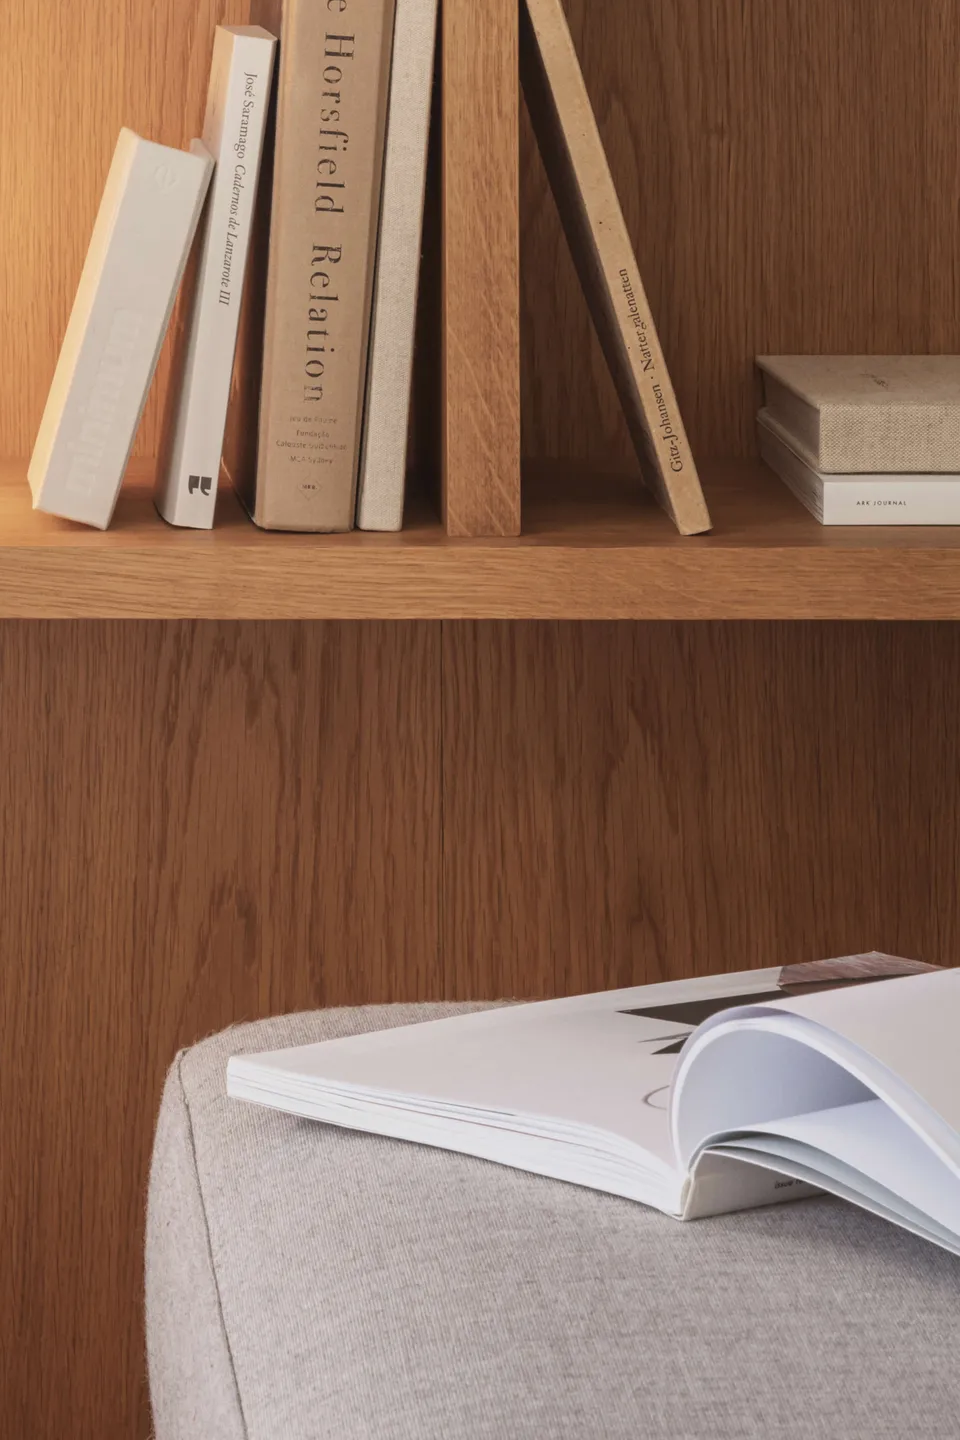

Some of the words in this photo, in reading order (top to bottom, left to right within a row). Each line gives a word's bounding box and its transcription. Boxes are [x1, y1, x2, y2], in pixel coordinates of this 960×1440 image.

[243, 71, 258, 97] José
[233, 100, 255, 159] Saramago
[314, 32, 355, 213] Horsfield
[228, 164, 246, 216] Cadernos
[227, 217, 240, 230] de
[220, 231, 238, 288] Lanzarote
[218, 289, 231, 306] III
[303, 243, 343, 404] Relation
[651, 383, 684, 472] Gitz-Johansen
